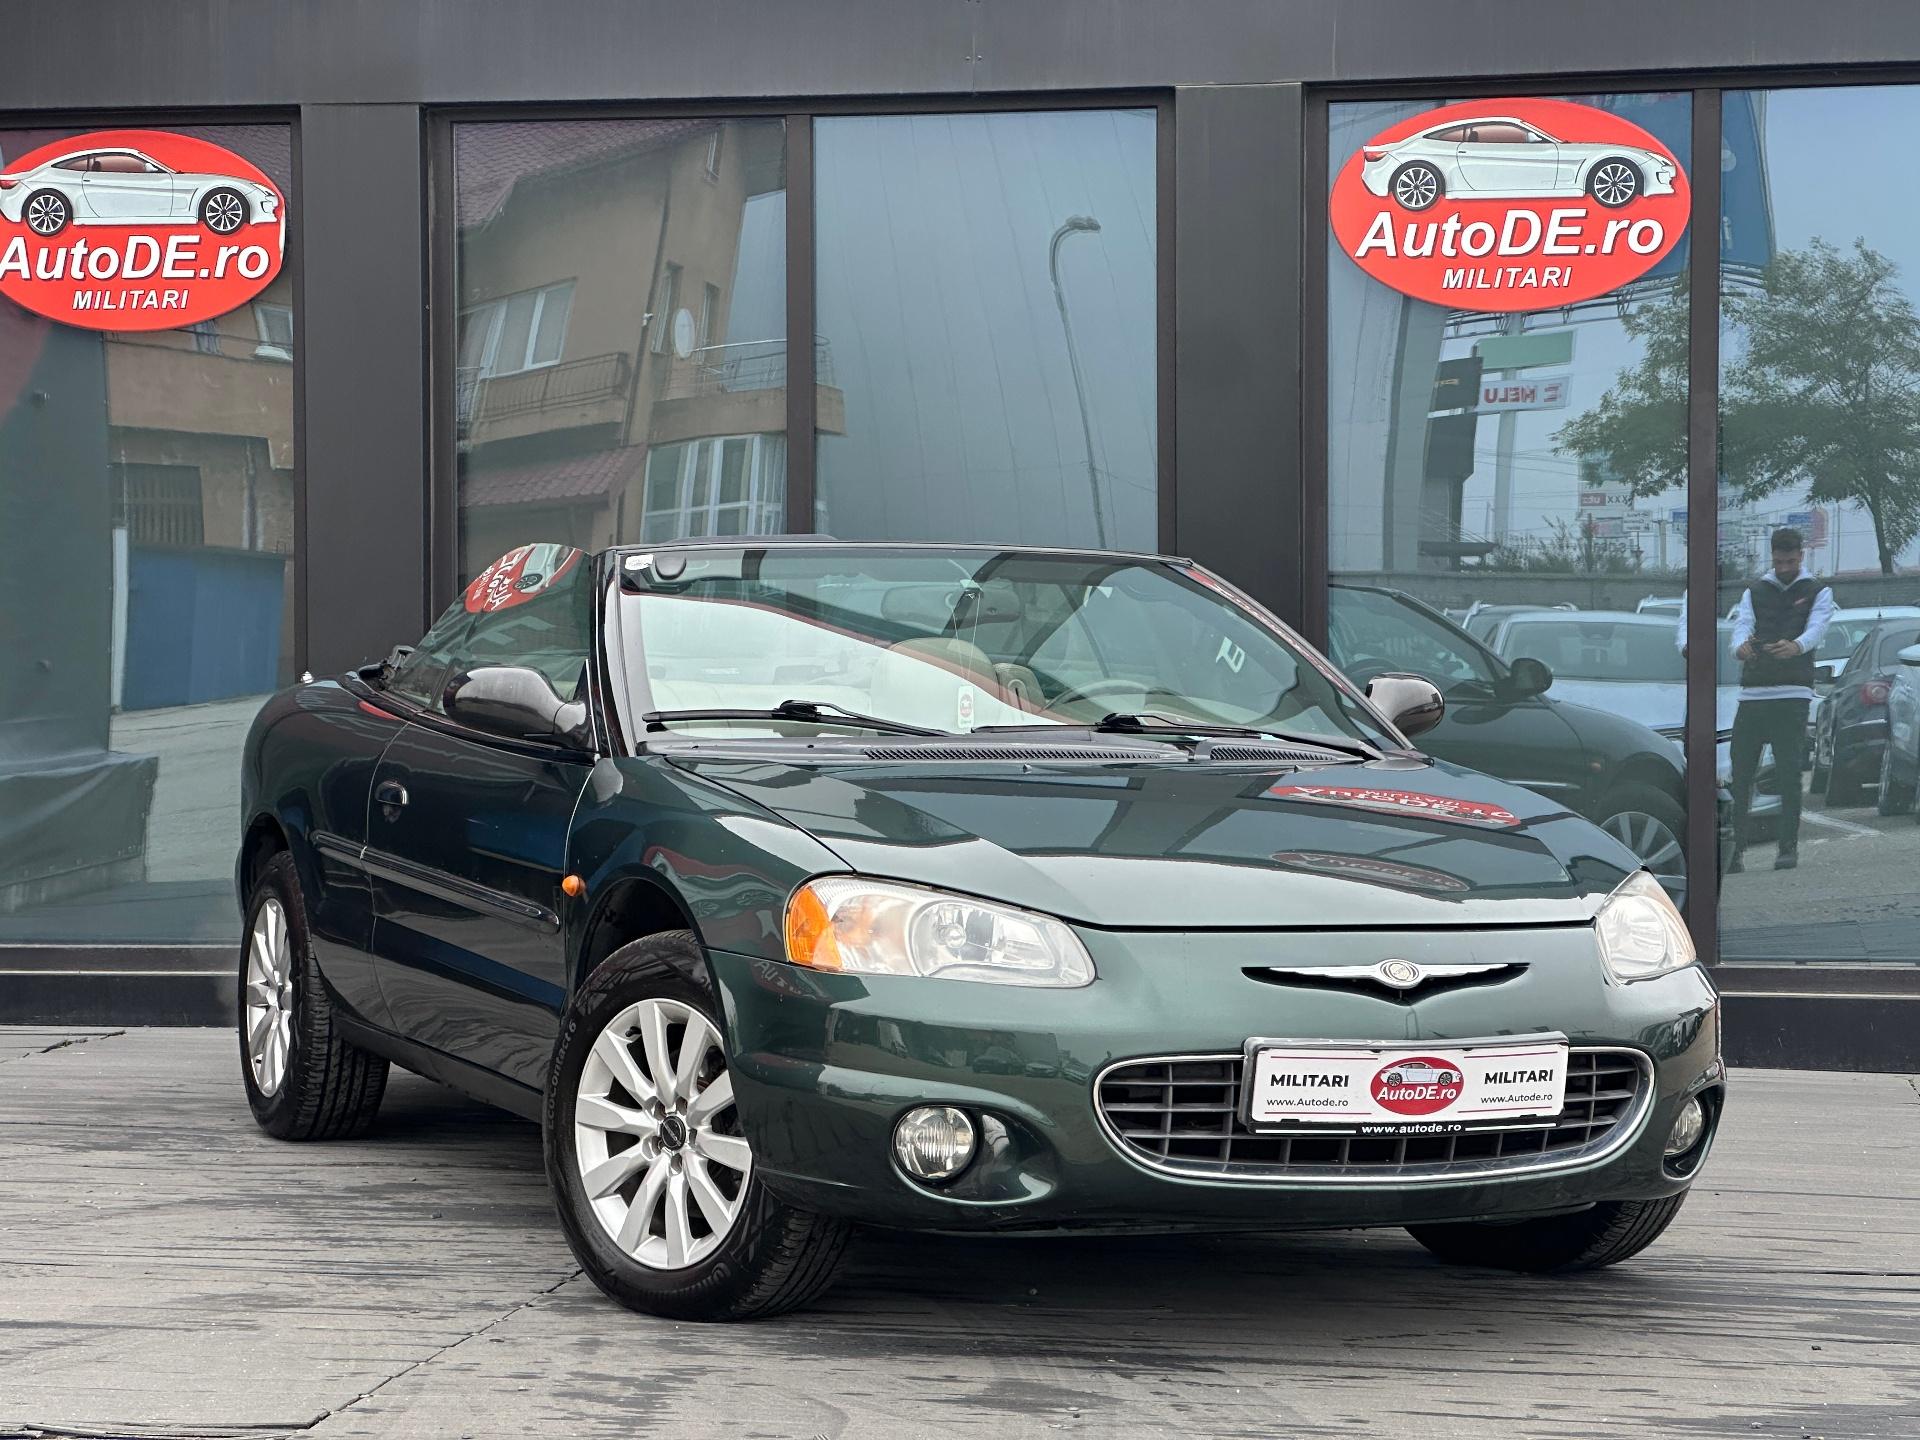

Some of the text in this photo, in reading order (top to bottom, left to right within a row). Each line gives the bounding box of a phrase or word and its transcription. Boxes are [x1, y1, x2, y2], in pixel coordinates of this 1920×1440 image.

[1354, 208, 1666, 258] AutoDE.ro
[0, 234, 270, 280] AutoDE.ro
[1442, 266, 1572, 289] MILITARI
[72, 289, 189, 310] MILITARI
[1270, 1074, 1349, 1088] MILITARI
[1484, 1069, 1554, 1086] MILITARI
[1376, 1085, 1457, 1101] AutoDE.ro
[1480, 1093, 1553, 1104] www.Autode.ro
[1266, 1097, 1349, 1107] www.Autode.ro
[1361, 1123, 1462, 1134] www.autode.ro
